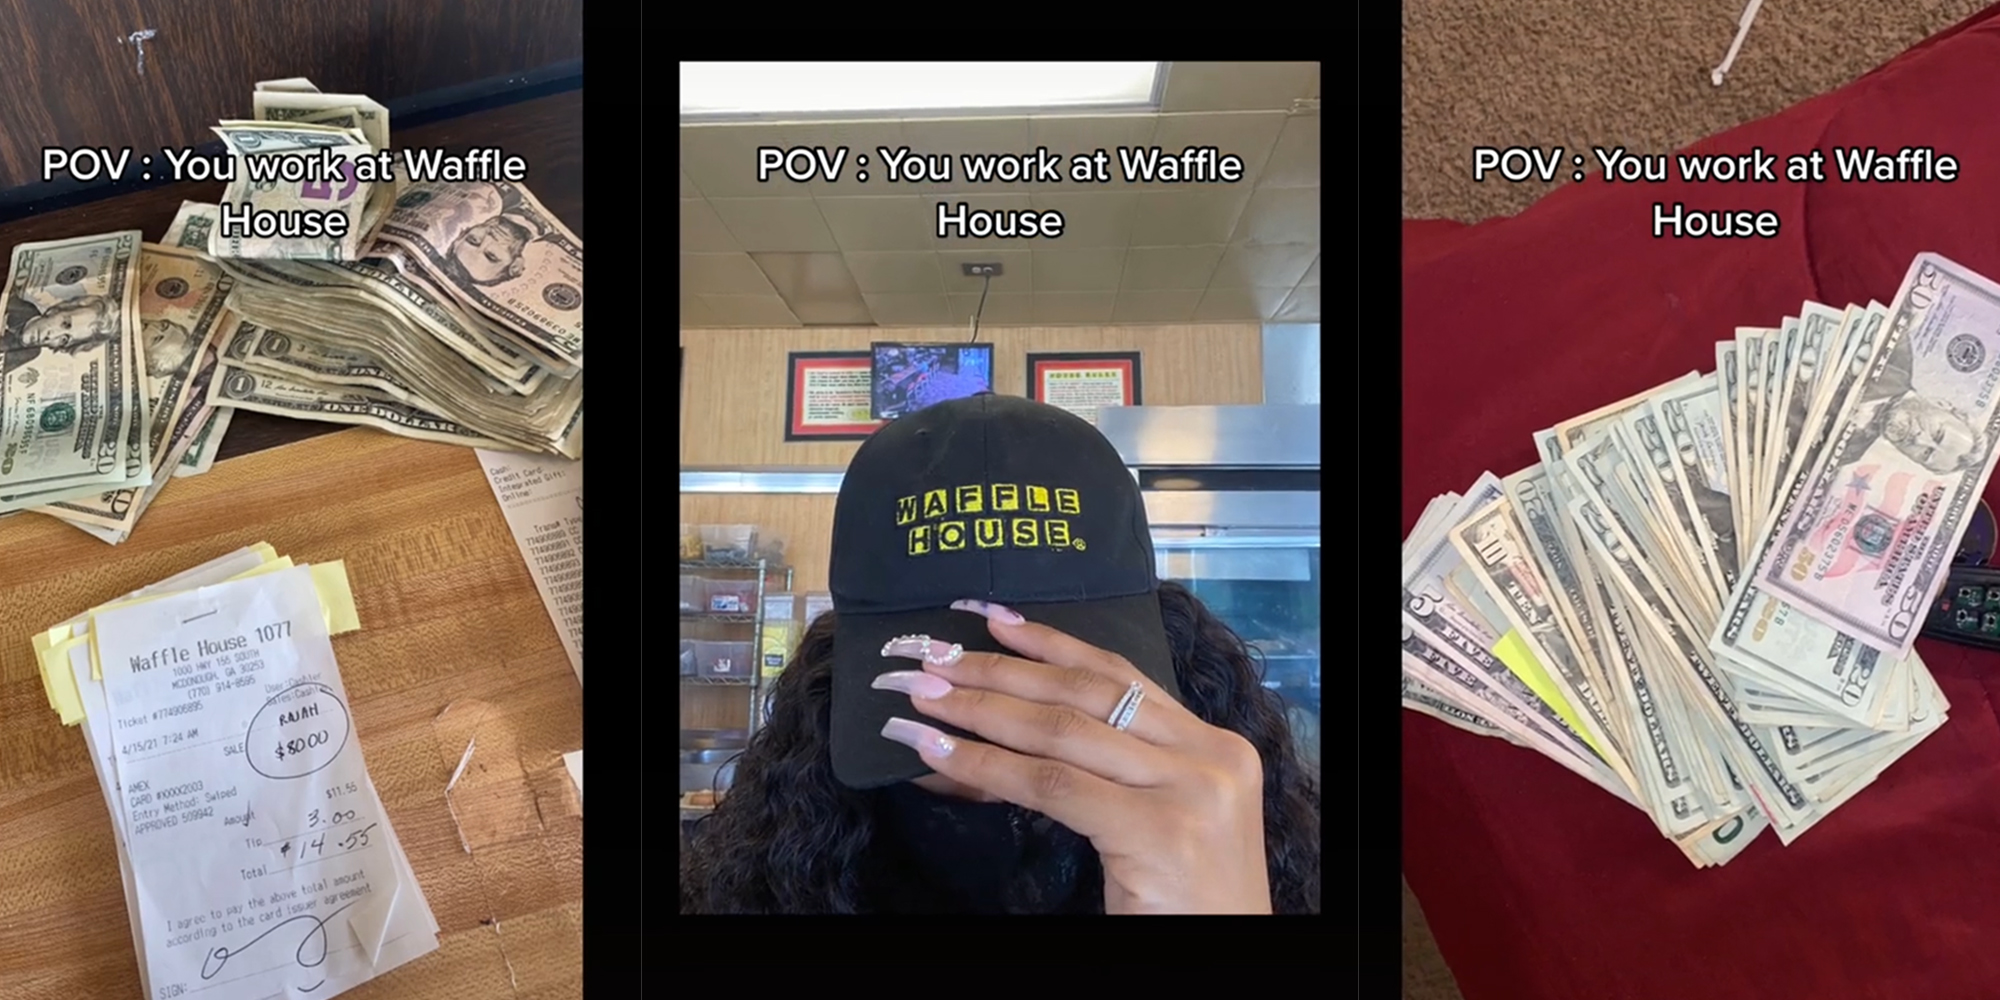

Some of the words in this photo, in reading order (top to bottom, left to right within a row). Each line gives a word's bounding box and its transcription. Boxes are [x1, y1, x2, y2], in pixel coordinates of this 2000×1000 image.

[323, 402, 367, 415] ONE
[369, 405, 456, 433] DOLLAR
[490, 465, 511, 477] Cash:
[494, 472, 520, 485] Credit
[522, 465, 544, 478] Card:
[499, 477, 543, 494] Integrated
[501, 489, 532, 502] Online:
[896, 483, 1081, 526] WAFFLE
[908, 518, 1071, 556] HOUSE
[1507, 580, 1542, 627] TEN
[129, 647, 190, 674] Waffle
[197, 634, 248, 658] House
[255, 620, 292, 643] 1077
[1440, 624, 1494, 669] FIVE
[172, 663, 193, 678] 1000
[234, 649, 260, 665] SOUTH
[225, 667, 236, 679] GA
[240, 660, 265, 675] 30253
[1422, 646, 1479, 688] FIVE
[187, 687, 211, 701] (770)
[117, 714, 148, 730] Ticket
[121, 738, 158, 756] 4/15/21
[162, 733, 184, 747] 7:24
[187, 728, 199, 740] AM
[223, 743, 244, 757] SALE
[128, 781, 150, 794] AMEX
[130, 794, 152, 808] CARD
[132, 806, 160, 822] Entry
[163, 797, 200, 814] Method:
[204, 786, 238, 805] Swiped
[134, 816, 179, 836] APPROVED
[244, 838, 263, 850] Tip
[240, 867, 268, 881] Total
[177, 914, 206, 930] agree
[210, 910, 222, 921] to
[227, 905, 243, 920] pay
[248, 897, 265, 910] the
[270, 889, 297, 905] above
[301, 881, 328, 895] total
[333, 870, 366, 886] amount
[166, 928, 217, 949] according
[221, 921, 233, 932] to
[238, 915, 255, 928] the
[259, 908, 282, 923] card
[288, 900, 318, 916] issuer
[324, 884, 372, 905] agreement
[159, 984, 188, 1000] SIGN:
